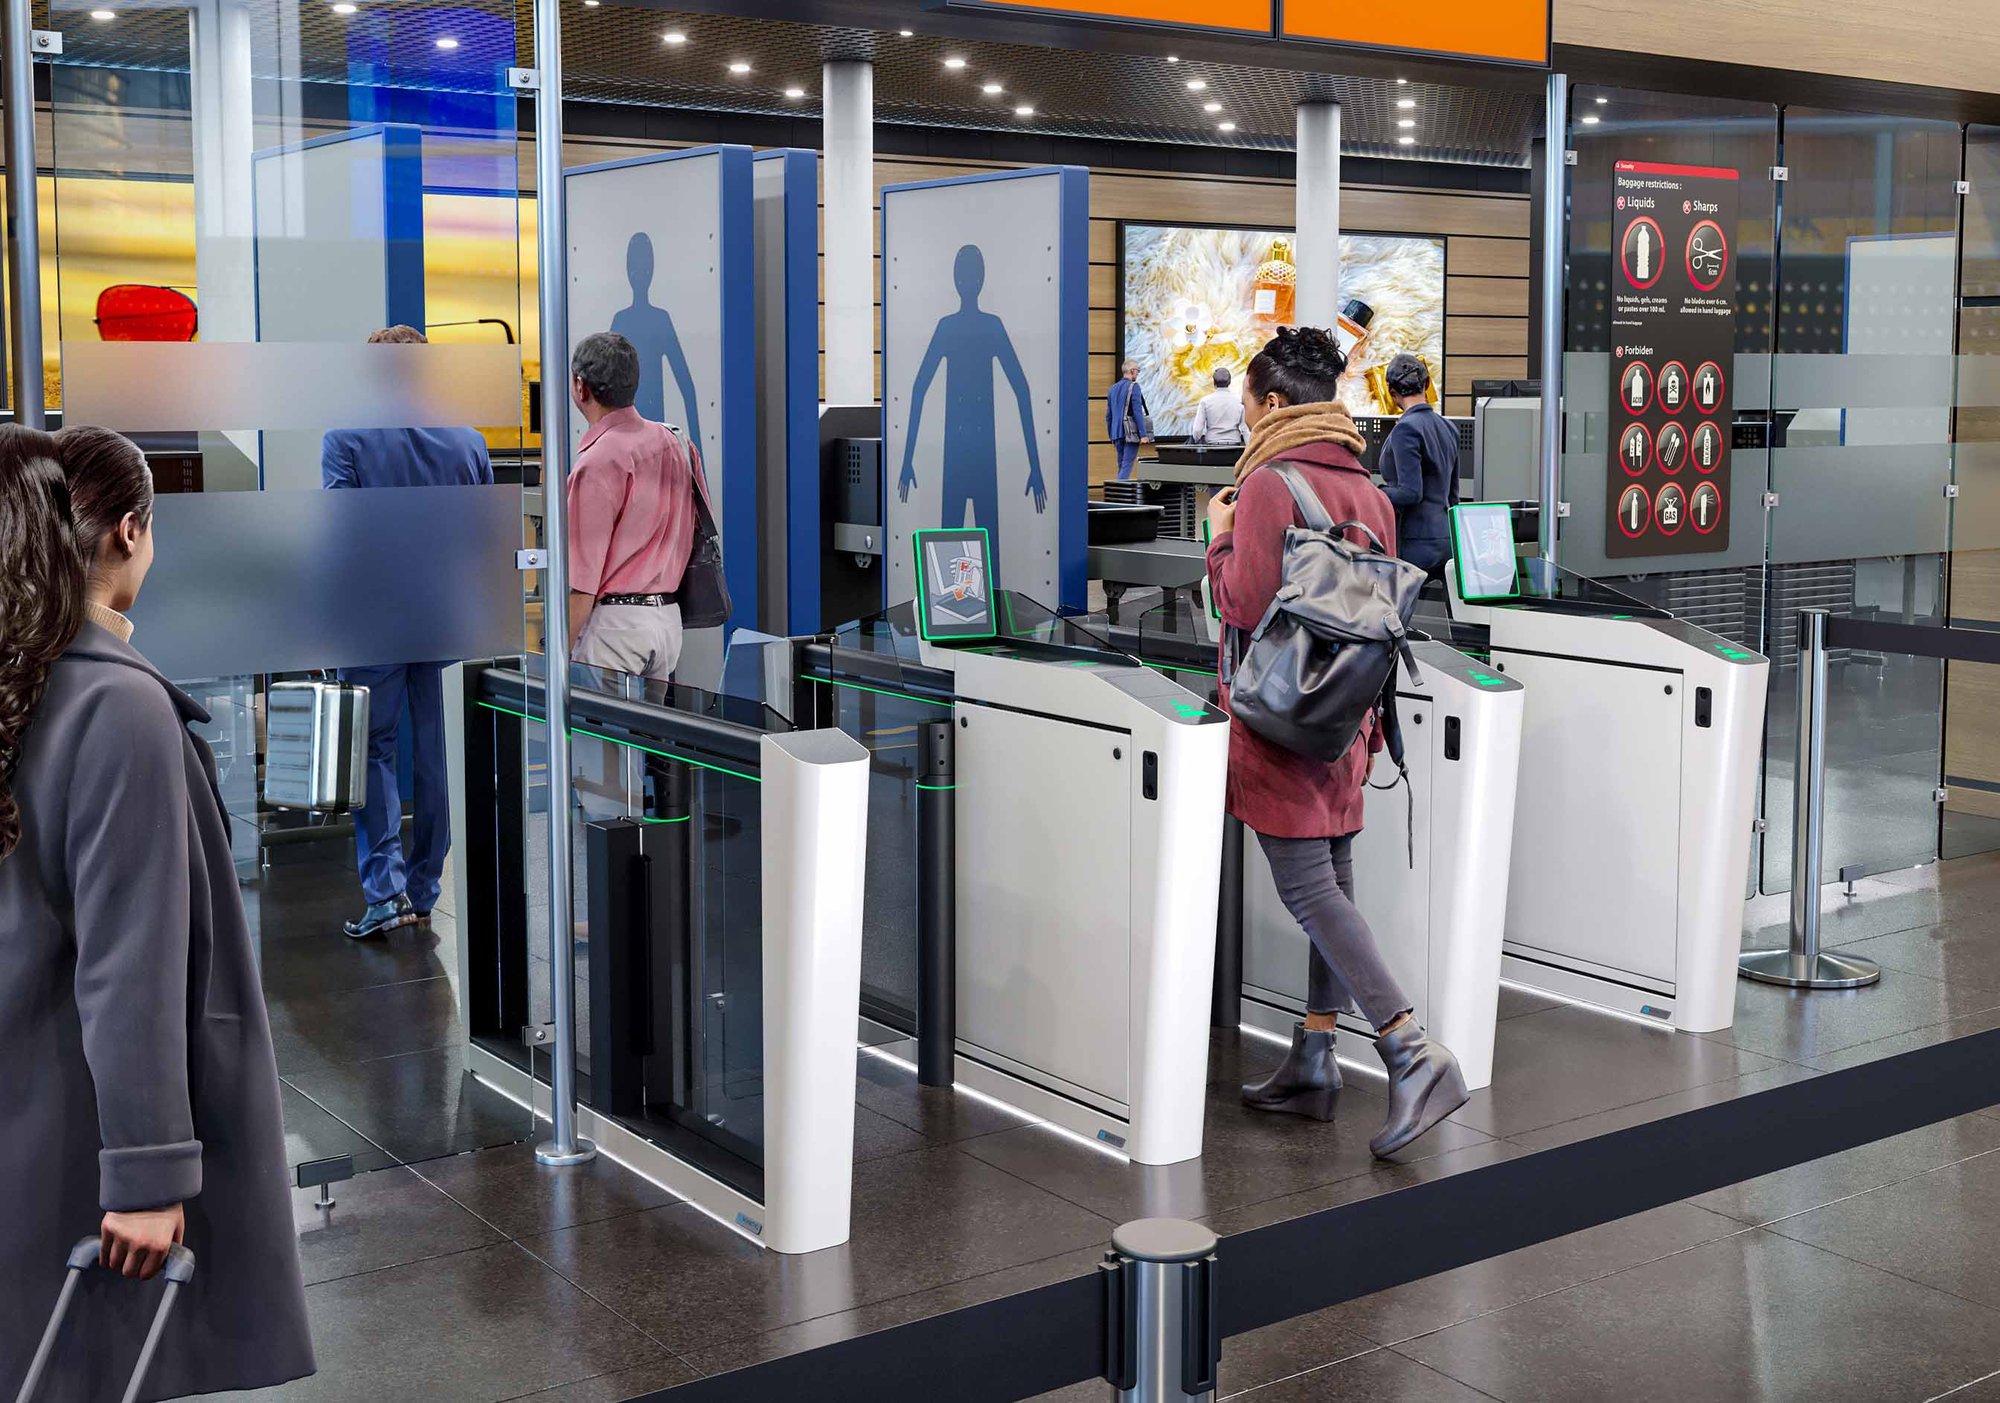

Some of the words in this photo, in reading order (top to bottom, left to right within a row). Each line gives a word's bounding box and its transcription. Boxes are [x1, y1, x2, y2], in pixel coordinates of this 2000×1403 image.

[1617, 176, 1645, 189] Baggage
[1627, 196, 1655, 210] Liquids
[1693, 200, 1718, 214] Sharps
[1616, 295, 1623, 303] No
[1691, 297, 1706, 305] blades
[1680, 306, 1697, 314] allowed
[1697, 306, 1702, 314] in
[1702, 306, 1714, 314] hand
[1714, 306, 1731, 316] luggage
[1624, 345, 1654, 356] Forbiden
[1664, 511, 1677, 521] GAS
